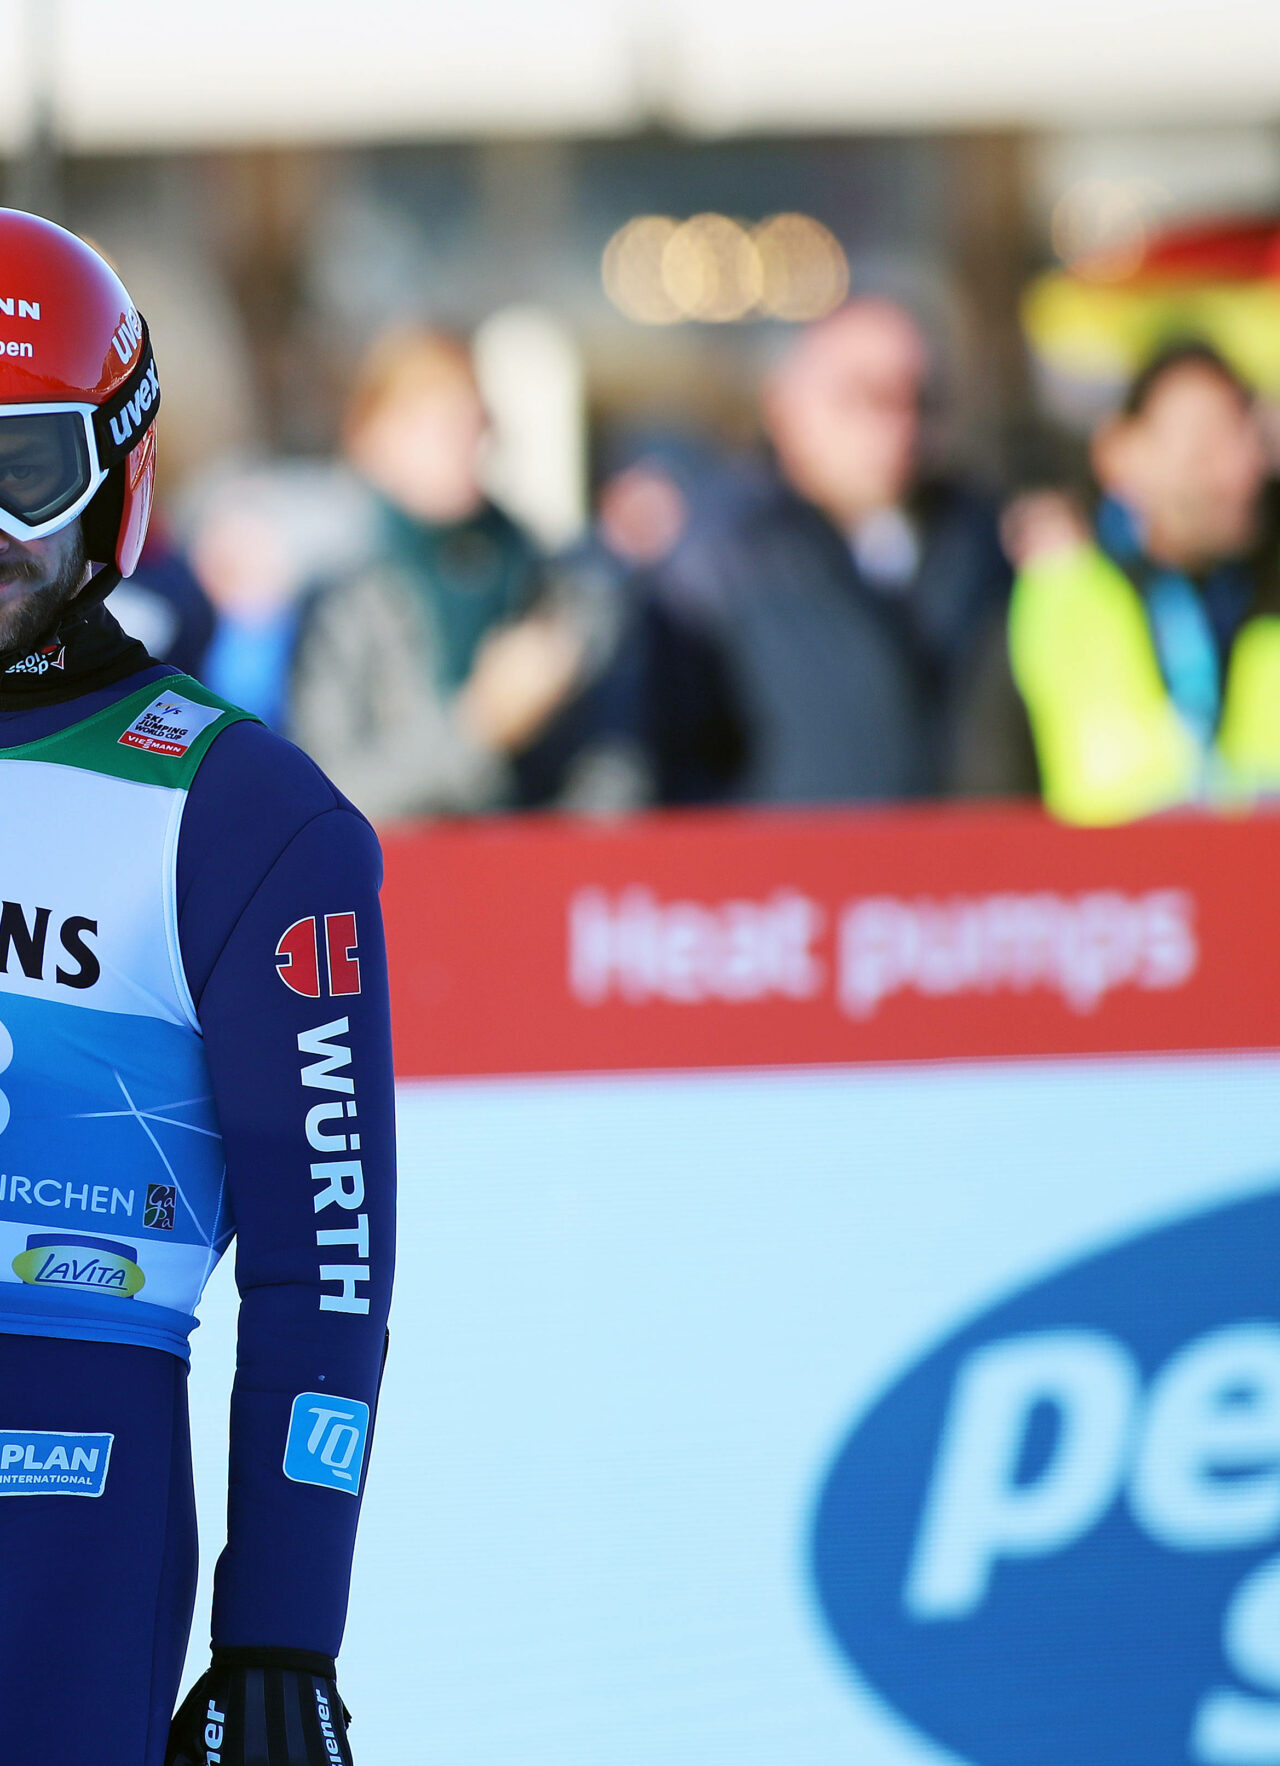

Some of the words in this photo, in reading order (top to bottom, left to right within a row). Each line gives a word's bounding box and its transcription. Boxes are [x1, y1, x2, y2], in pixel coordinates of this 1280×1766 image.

[109, 358, 159, 446] uvex
[144, 713, 164, 724] SKI
[155, 702, 182, 715] FIS
[134, 724, 165, 738] WORLD
[164, 733, 182, 741] CUP
[139, 719, 189, 736] JUMPING
[128, 735, 182, 753] VIESSMANN
[570, 888, 820, 1002] Heat
[838, 890, 1196, 1018] pumps
[297, 1016, 370, 1315] WÜRTH
[307, 1407, 360, 1480] TQ
[0, 1444, 100, 1472] PLAN
[315, 1688, 344, 1766] iener
